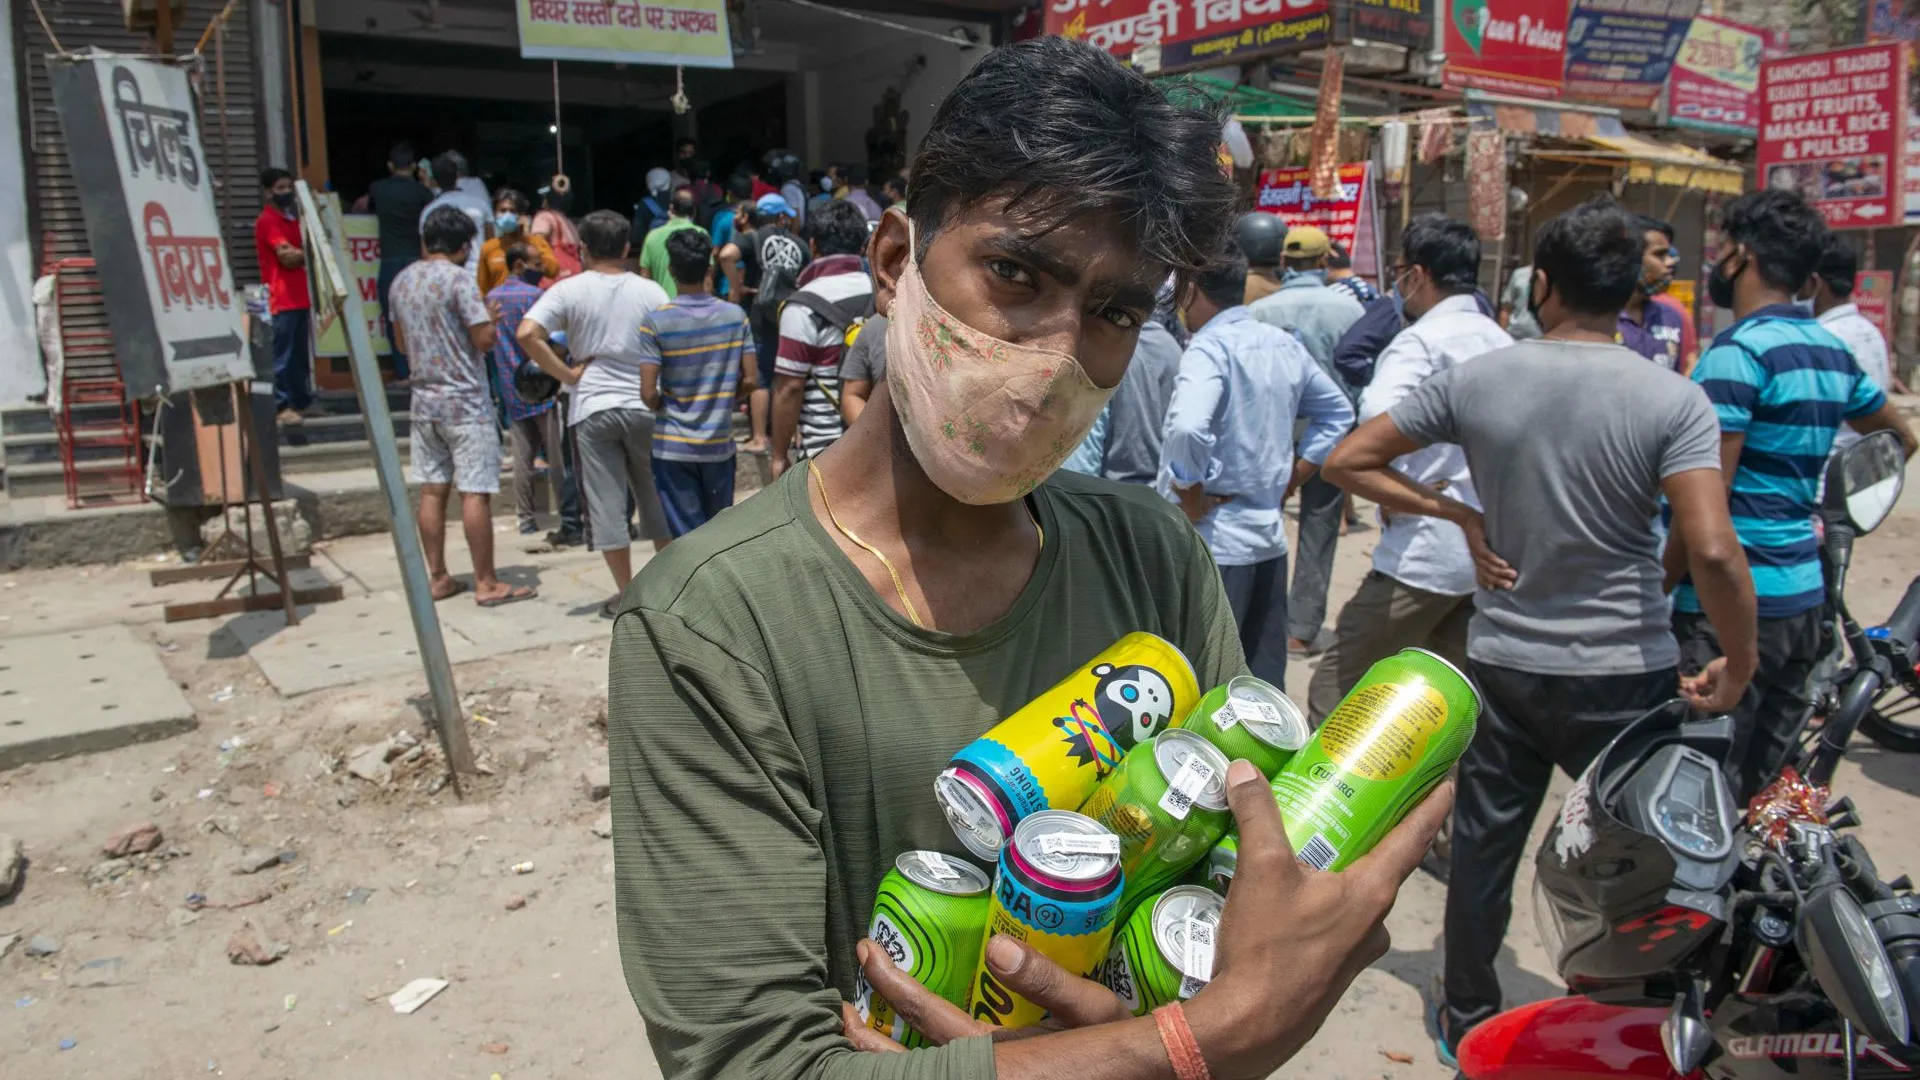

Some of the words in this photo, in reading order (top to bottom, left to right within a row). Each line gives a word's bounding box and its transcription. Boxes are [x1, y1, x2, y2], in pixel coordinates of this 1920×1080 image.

[1478, 6, 1517, 42] Paan
[1517, 14, 1564, 52] Palace
[1833, 51, 1891, 75] TRADERS
[1771, 101, 1810, 121] DRY
[1811, 92, 1883, 117] FRUITS,
[1763, 117, 1844, 142] MASALE,
[1846, 111, 1890, 134] RICE
[1782, 141, 1798, 160] &
[1801, 135, 1870, 158] PULSES
[143, 201, 230, 311] बियर
[1010, 766, 1043, 813] STRONG
[1001, 874, 1032, 921] RA
